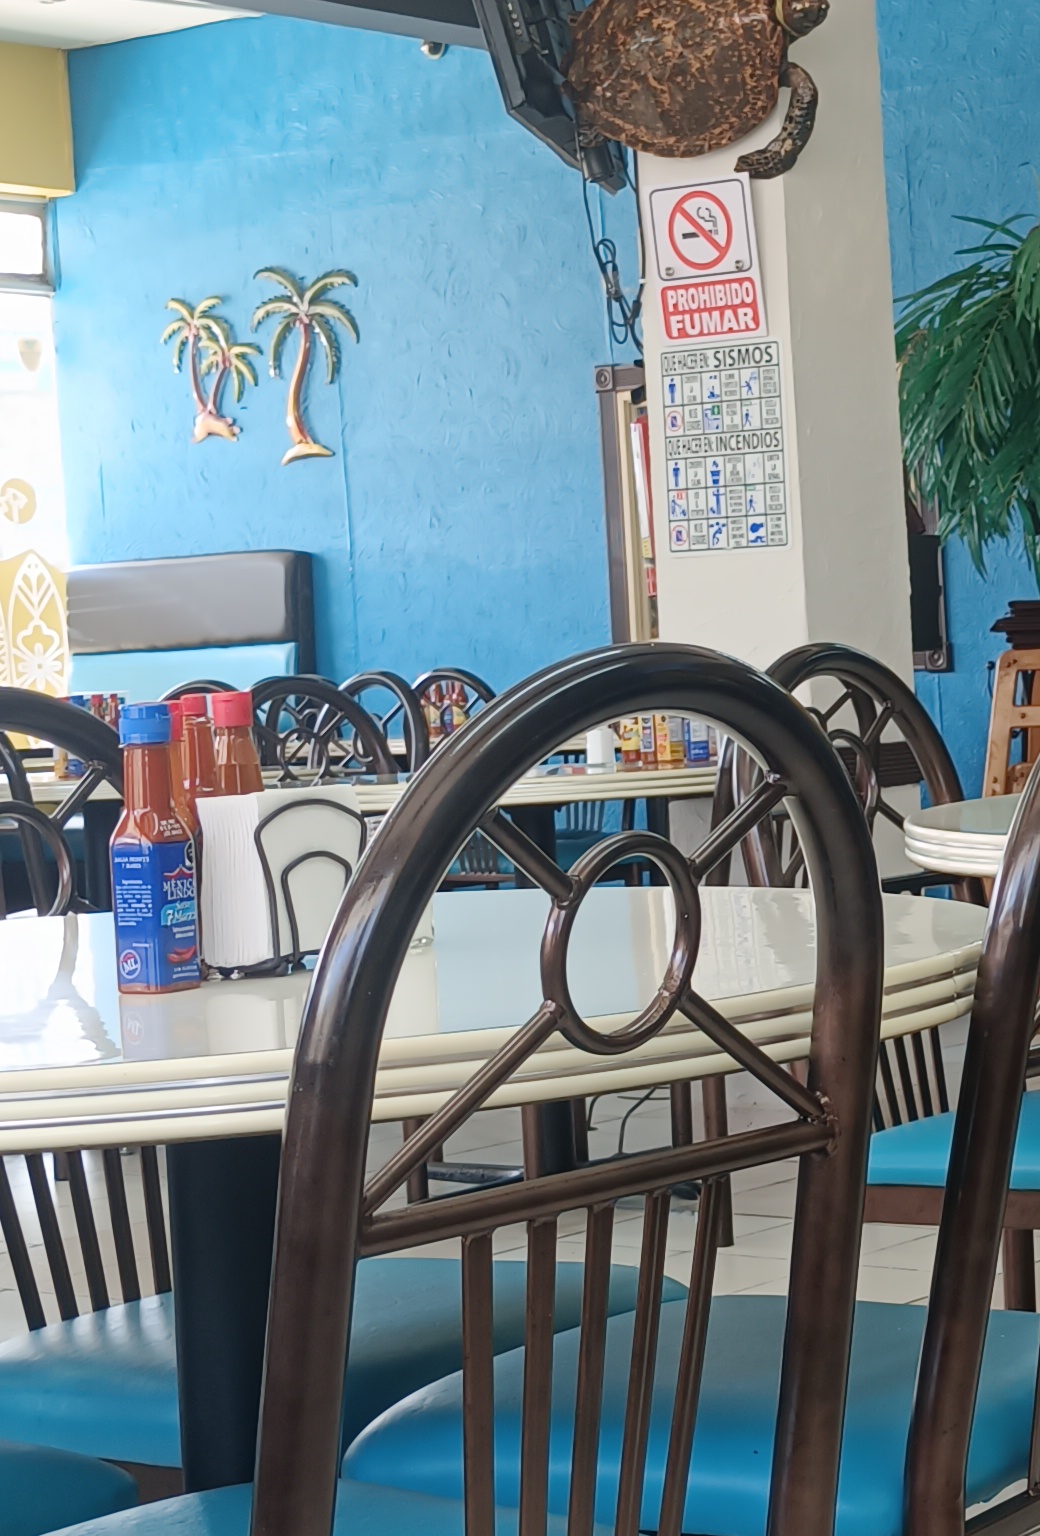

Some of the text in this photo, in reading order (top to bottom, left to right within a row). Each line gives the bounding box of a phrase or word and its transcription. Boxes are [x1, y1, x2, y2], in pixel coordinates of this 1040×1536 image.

[667, 281, 754, 312] PROHIBIDO
[670, 307, 756, 337] FUMAR
[714, 345, 773, 368] SISMOS
[715, 431, 780, 452] INCENDIOS
[166, 910, 173, 925] 7
